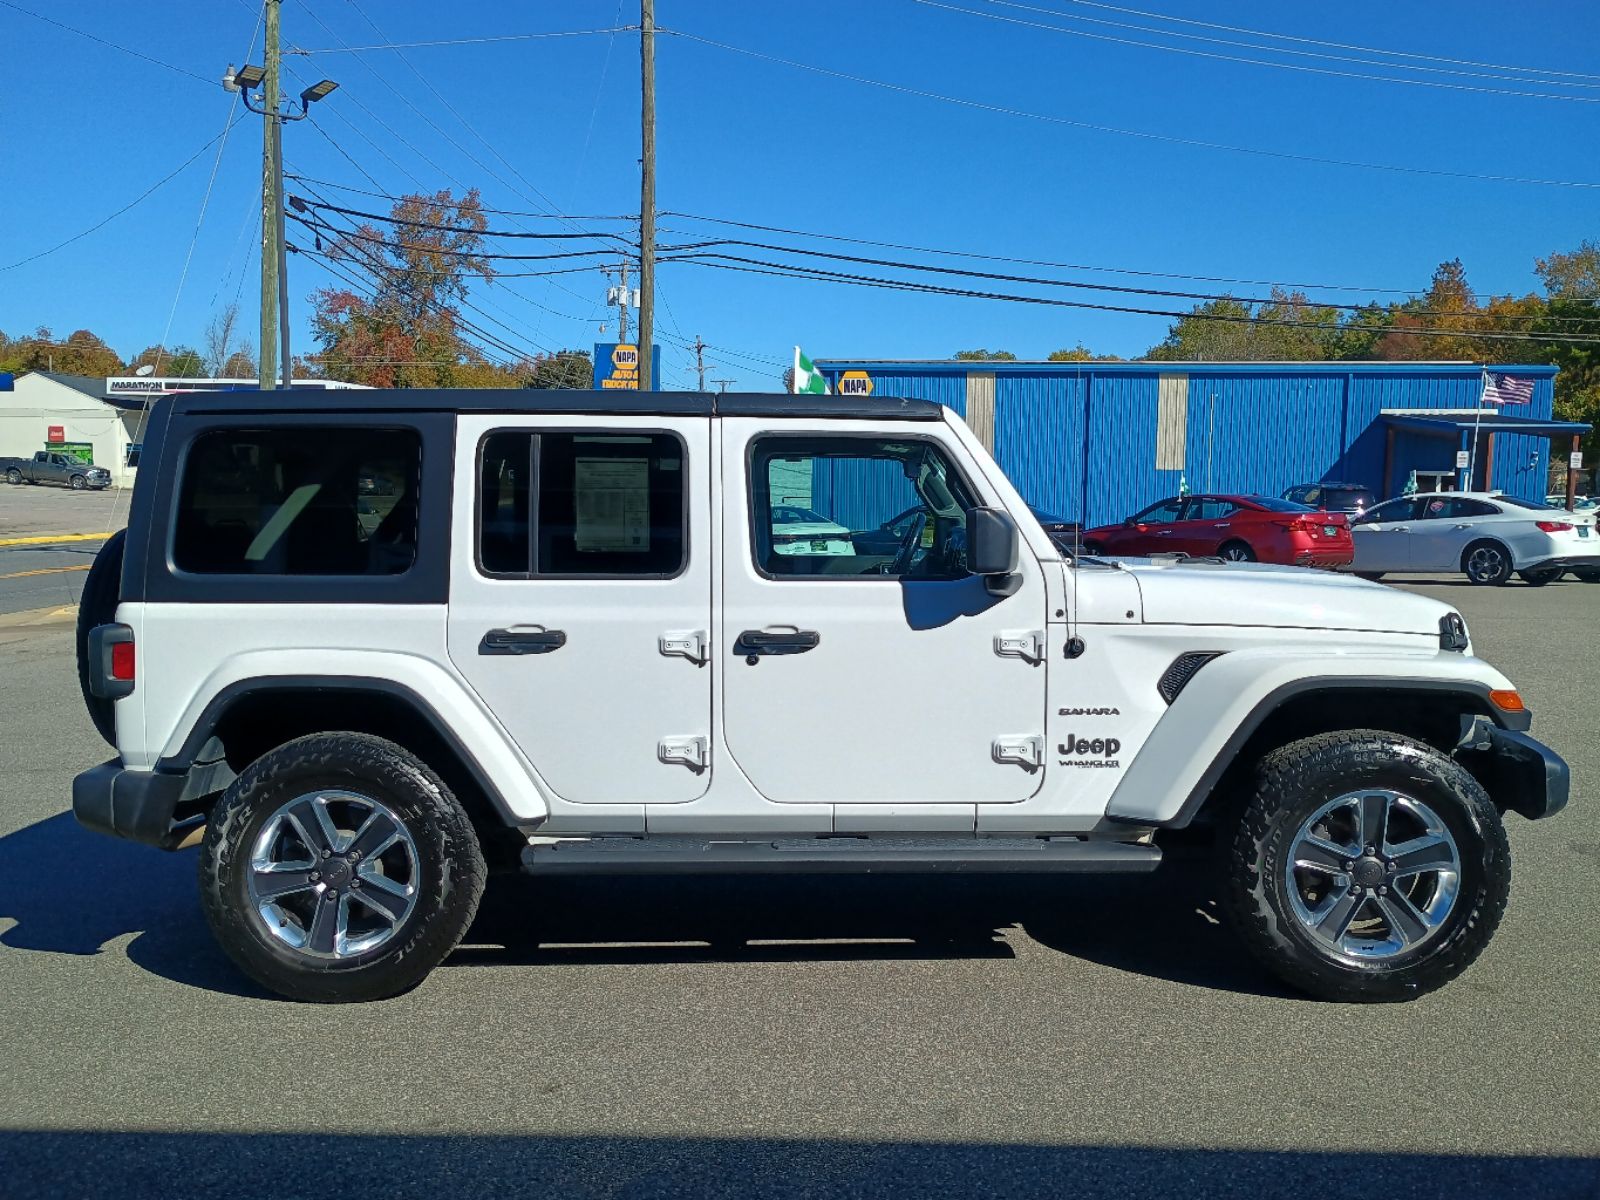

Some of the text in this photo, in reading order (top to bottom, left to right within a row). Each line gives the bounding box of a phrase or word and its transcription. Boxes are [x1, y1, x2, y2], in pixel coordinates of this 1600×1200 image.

[616, 351, 636, 363] NAPA
[612, 370, 633, 379] AUTO
[111, 381, 163, 389] MARATHON
[843, 379, 867, 394] NAPA
[1058, 733, 1121, 758] Jeep
[1058, 760, 1120, 768] WRANGLER
